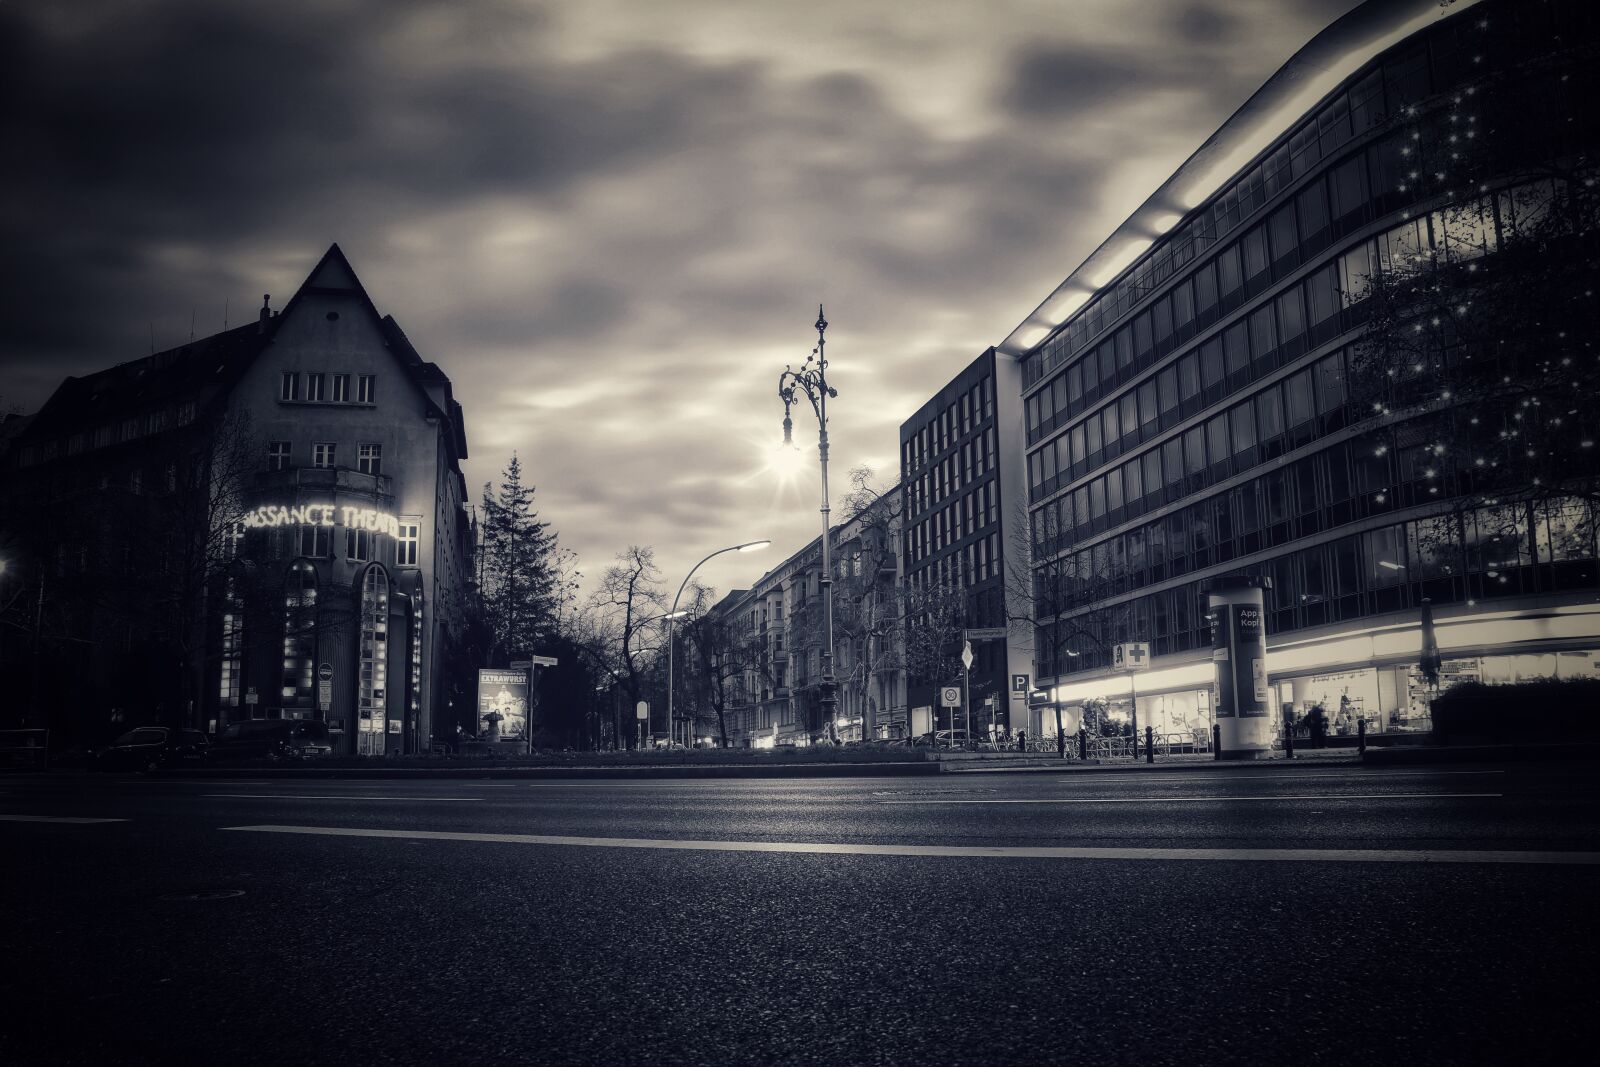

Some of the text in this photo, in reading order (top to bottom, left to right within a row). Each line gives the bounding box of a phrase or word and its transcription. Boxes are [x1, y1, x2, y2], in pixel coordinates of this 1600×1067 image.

[1240, 609, 1257, 619] App
[481, 675, 526, 683] EXTRAWURST
[1016, 676, 1026, 690] P
[947, 691, 955, 699] 30
